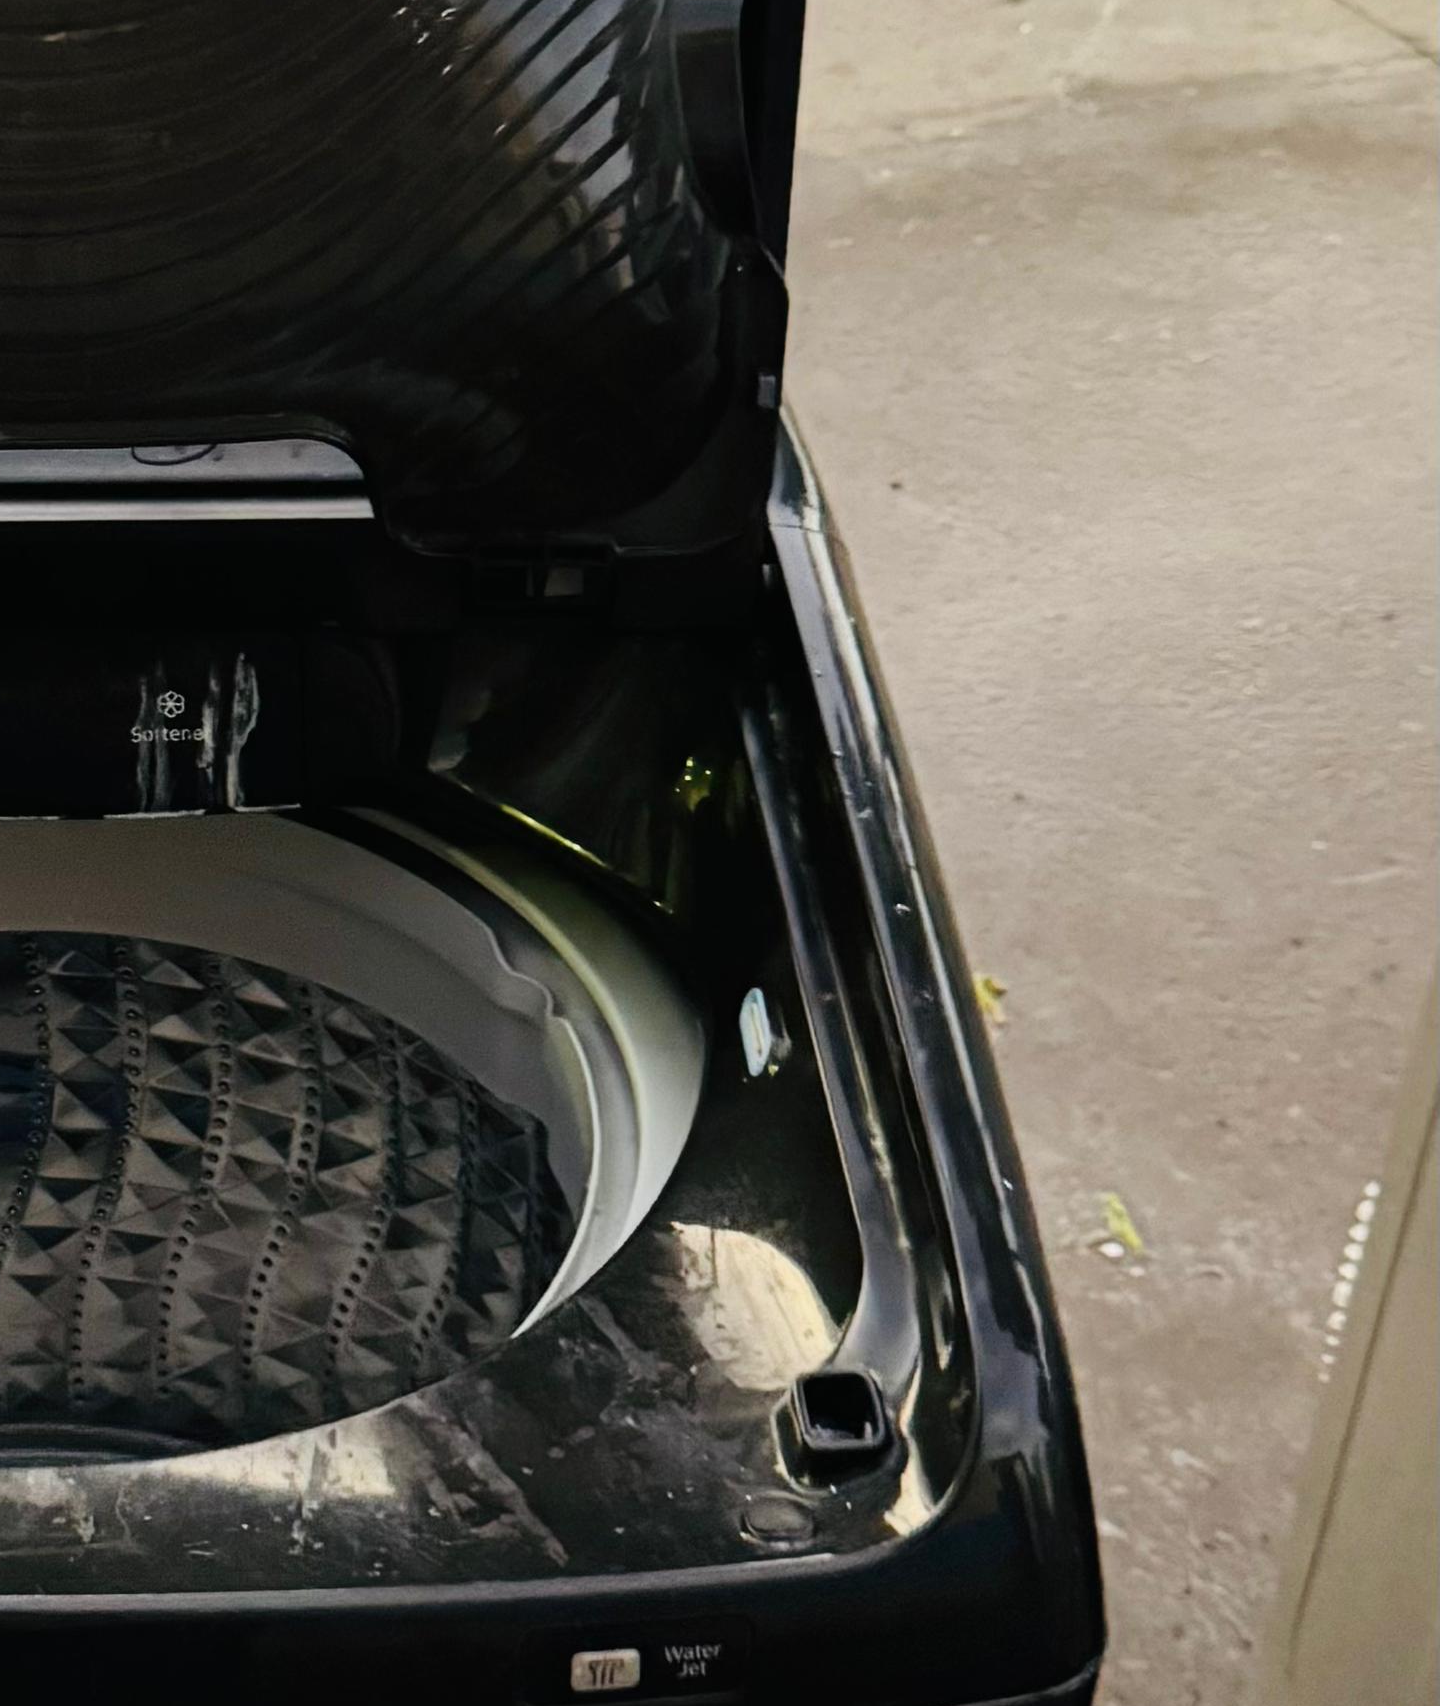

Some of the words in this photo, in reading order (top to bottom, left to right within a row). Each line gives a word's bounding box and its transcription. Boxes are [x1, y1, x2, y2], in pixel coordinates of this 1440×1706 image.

[131, 725, 212, 743] Softene
[664, 1644, 722, 1663] Water
[677, 1660, 707, 1678] Jet
